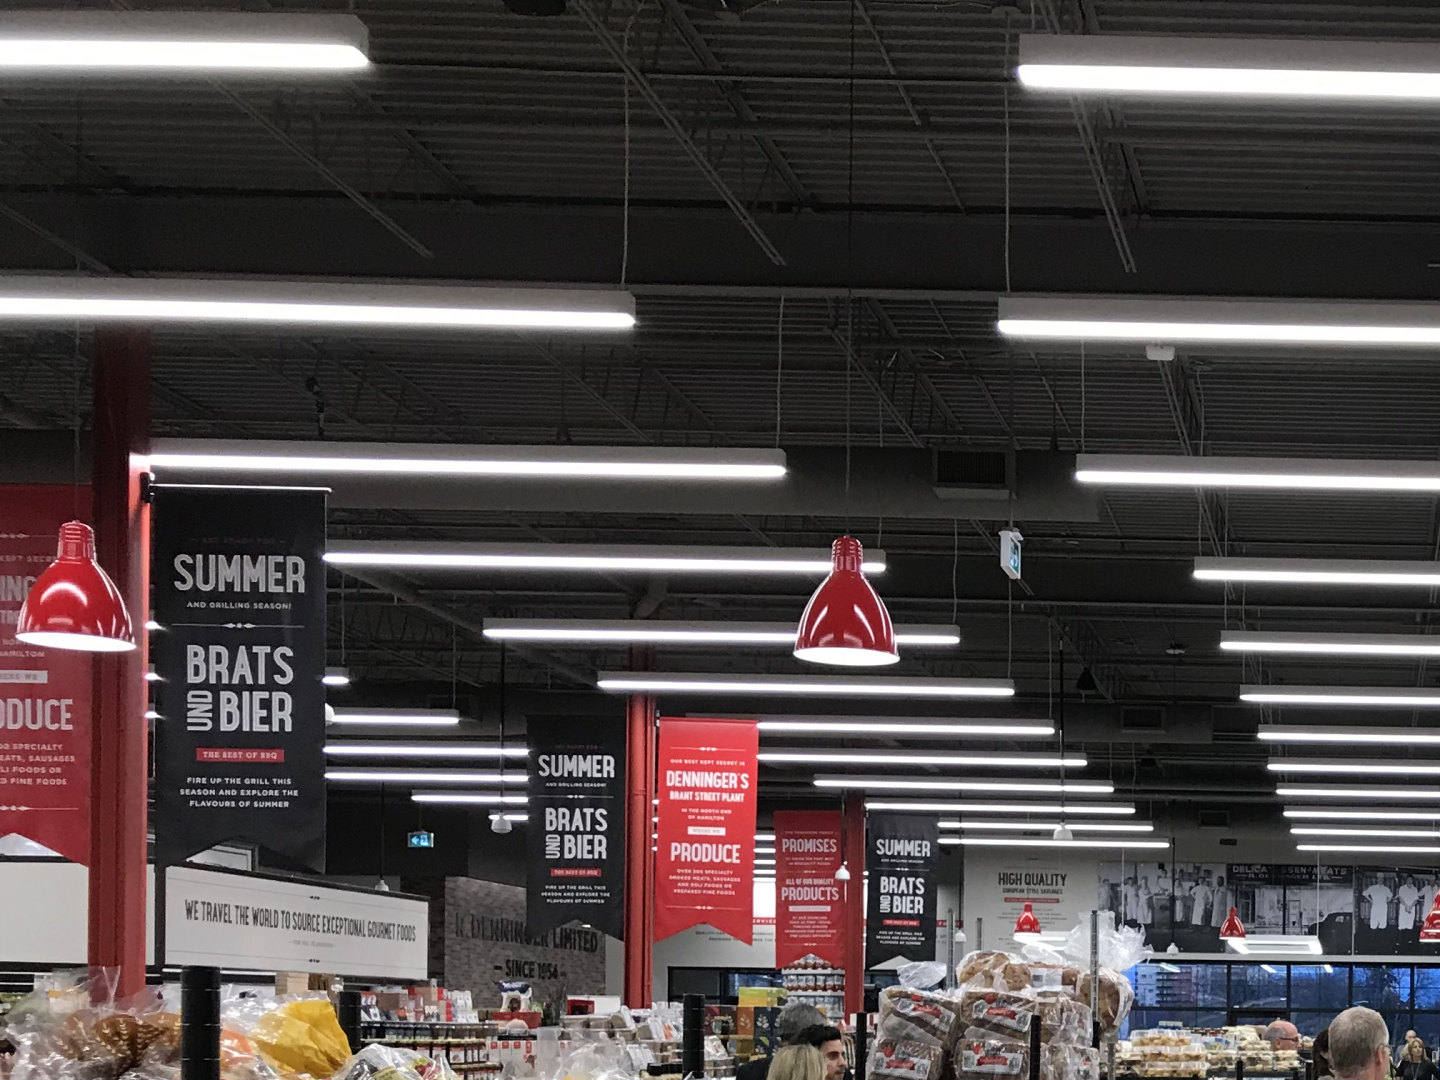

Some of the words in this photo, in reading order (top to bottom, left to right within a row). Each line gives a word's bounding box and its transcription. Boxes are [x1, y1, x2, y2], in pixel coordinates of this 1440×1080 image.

[173, 553, 305, 593] SUMMER
[187, 645, 294, 685] BRATS
[187, 690, 212, 731] UND
[219, 690, 293, 732] BIER
[222, 751, 243, 759] BEST
[538, 754, 615, 778] SUMMER
[36, 778, 67, 786] FOODS
[666, 770, 750, 789] DENNINGER'S
[180, 788, 215, 796] SEASON
[669, 791, 693, 801] BRANT
[695, 792, 720, 802] STREET
[721, 793, 745, 803] PLANT
[545, 807, 608, 832] BRATS
[545, 834, 561, 859] UND
[563, 834, 607, 860] BIER
[670, 842, 741, 864] PRODUCE
[782, 838, 837, 853] PROMISES
[876, 839, 931, 857] SUMMER
[880, 877, 925, 895] BRATS
[998, 872, 1022, 886] HIGH
[1024, 873, 1067, 886] QUALITY
[781, 887, 839, 901] PRODUCTS
[880, 895, 891, 913] UND
[892, 896, 924, 915] BIER
[185, 899, 199, 921] WE
[201, 901, 233, 924] TRAVEL
[235, 905, 250, 926] THE
[252, 907, 278, 929] WORLD
[281, 910, 291, 930] TO
[292, 911, 321, 933] SOURCE
[322, 915, 367, 938] EXCEPTIONAL
[367, 921, 396, 941] GOURMET
[397, 924, 416, 942] FOODS
[552, 927, 598, 952] LIMITED
[505, 959, 535, 978] SINCE
